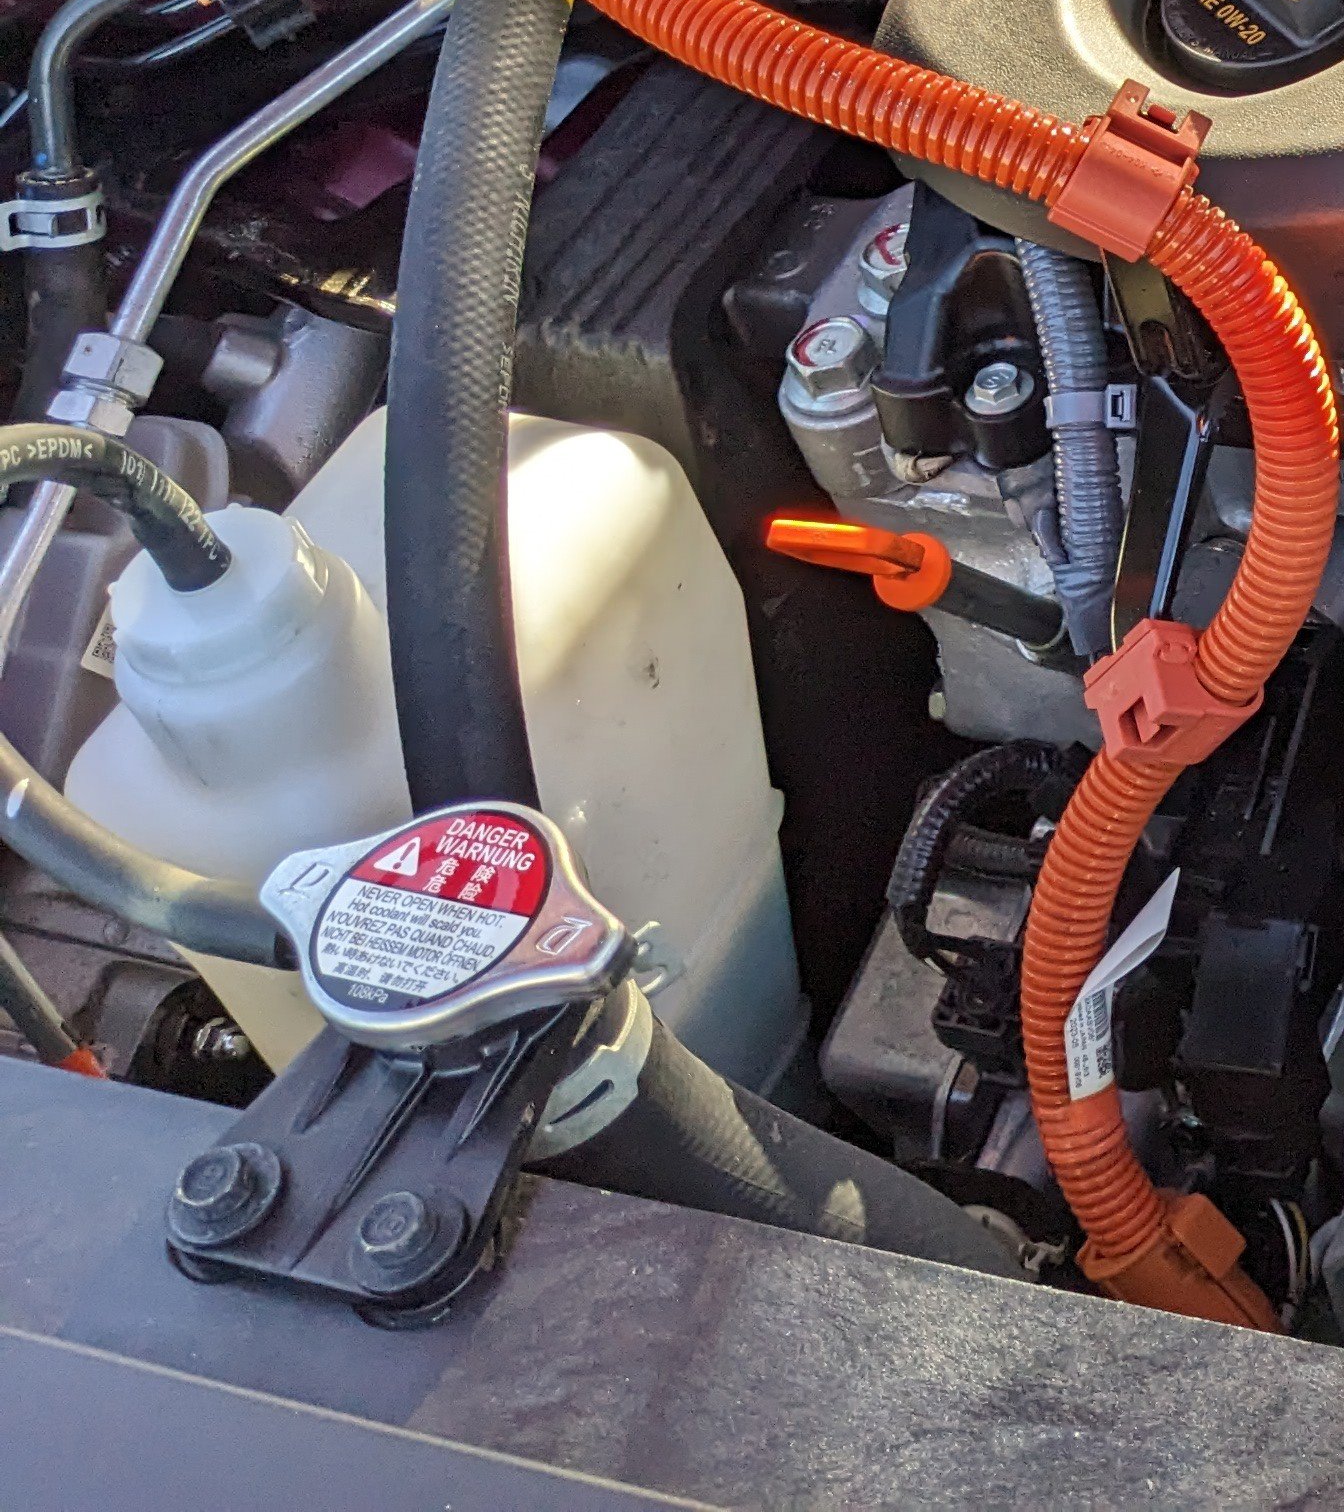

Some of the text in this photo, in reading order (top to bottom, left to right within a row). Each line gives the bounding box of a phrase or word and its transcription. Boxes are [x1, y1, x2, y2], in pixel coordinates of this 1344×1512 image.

[1216, 4, 1267, 45] 0W-20
[446, 818, 530, 850] DANGER
[435, 834, 536, 871] WARNUNG
[348, 898, 370, 913] Hot
[369, 904, 411, 922] coolant
[410, 913, 431, 927] will
[428, 918, 462, 933] scald
[357, 884, 506, 929] NEVER OPEN WHEN HOT.
[321, 925, 352, 941] NICHT
[349, 932, 369, 946] BEI
[407, 946, 444, 963] MOTOR
[384, 923, 411, 938] PAS
[410, 929, 454, 949] QUAND
[452, 938, 496, 959] CHAUD.
[347, 983, 390, 1004] 108kPa
